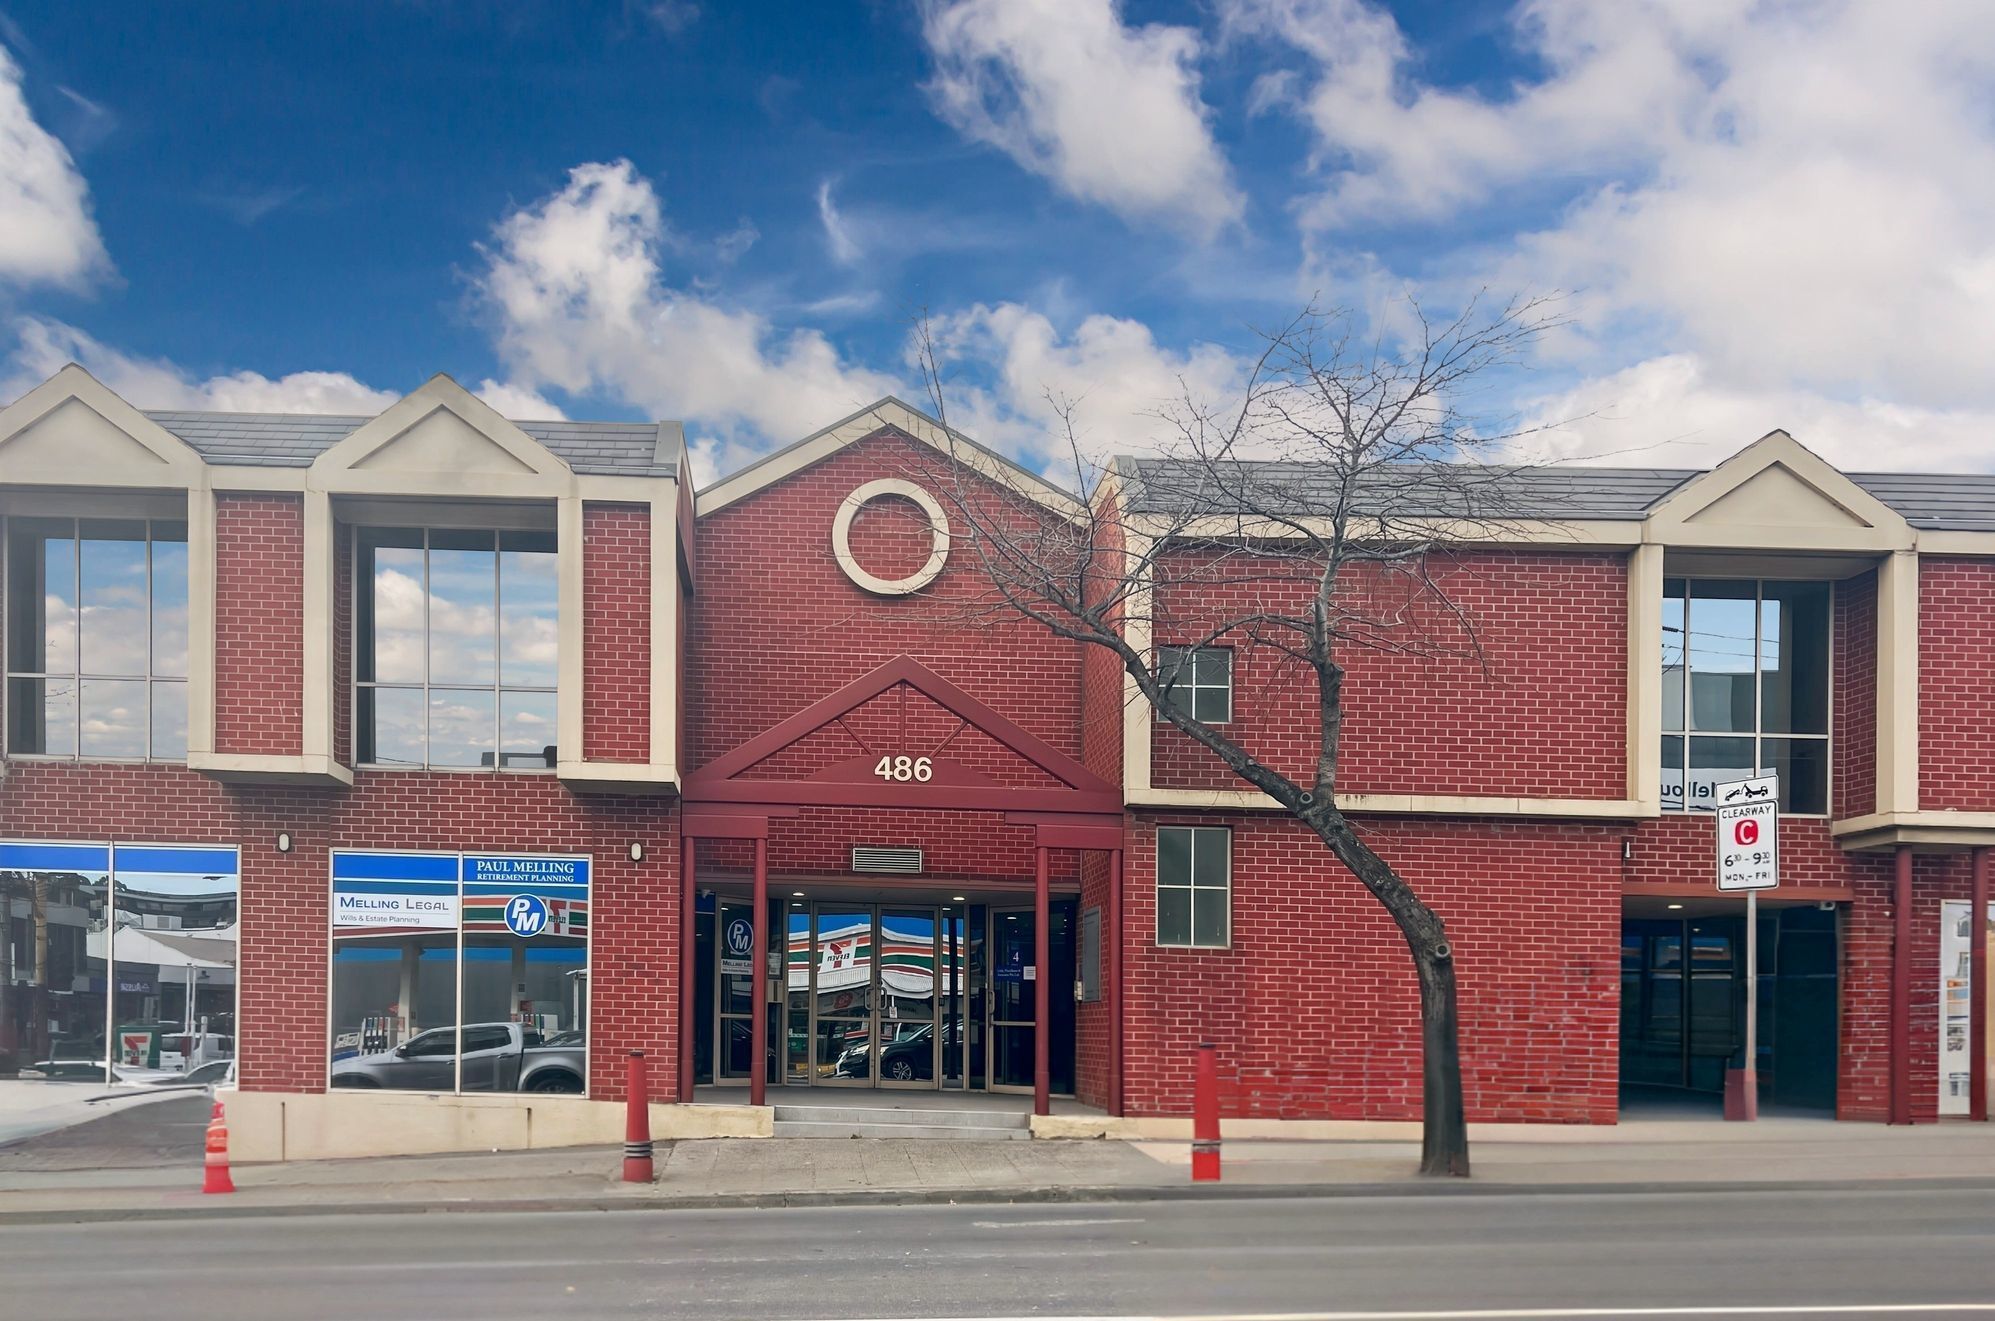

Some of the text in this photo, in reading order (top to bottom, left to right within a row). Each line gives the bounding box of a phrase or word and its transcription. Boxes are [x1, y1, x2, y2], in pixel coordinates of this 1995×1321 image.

[874, 755, 933, 782] 486
[1721, 805, 1772, 819] CLEARWAY
[1739, 821, 1754, 844] C
[477, 860, 574, 874] PAUL MELLING
[477, 873, 574, 882] RETIREMENT PLANNING
[1755, 871, 1770, 880] FRI
[340, 896, 449, 911] MELLING LEGAL
[340, 914, 357, 922] Wills
[389, 915, 420, 924] Planning
[1012, 951, 1019, 962] 4
